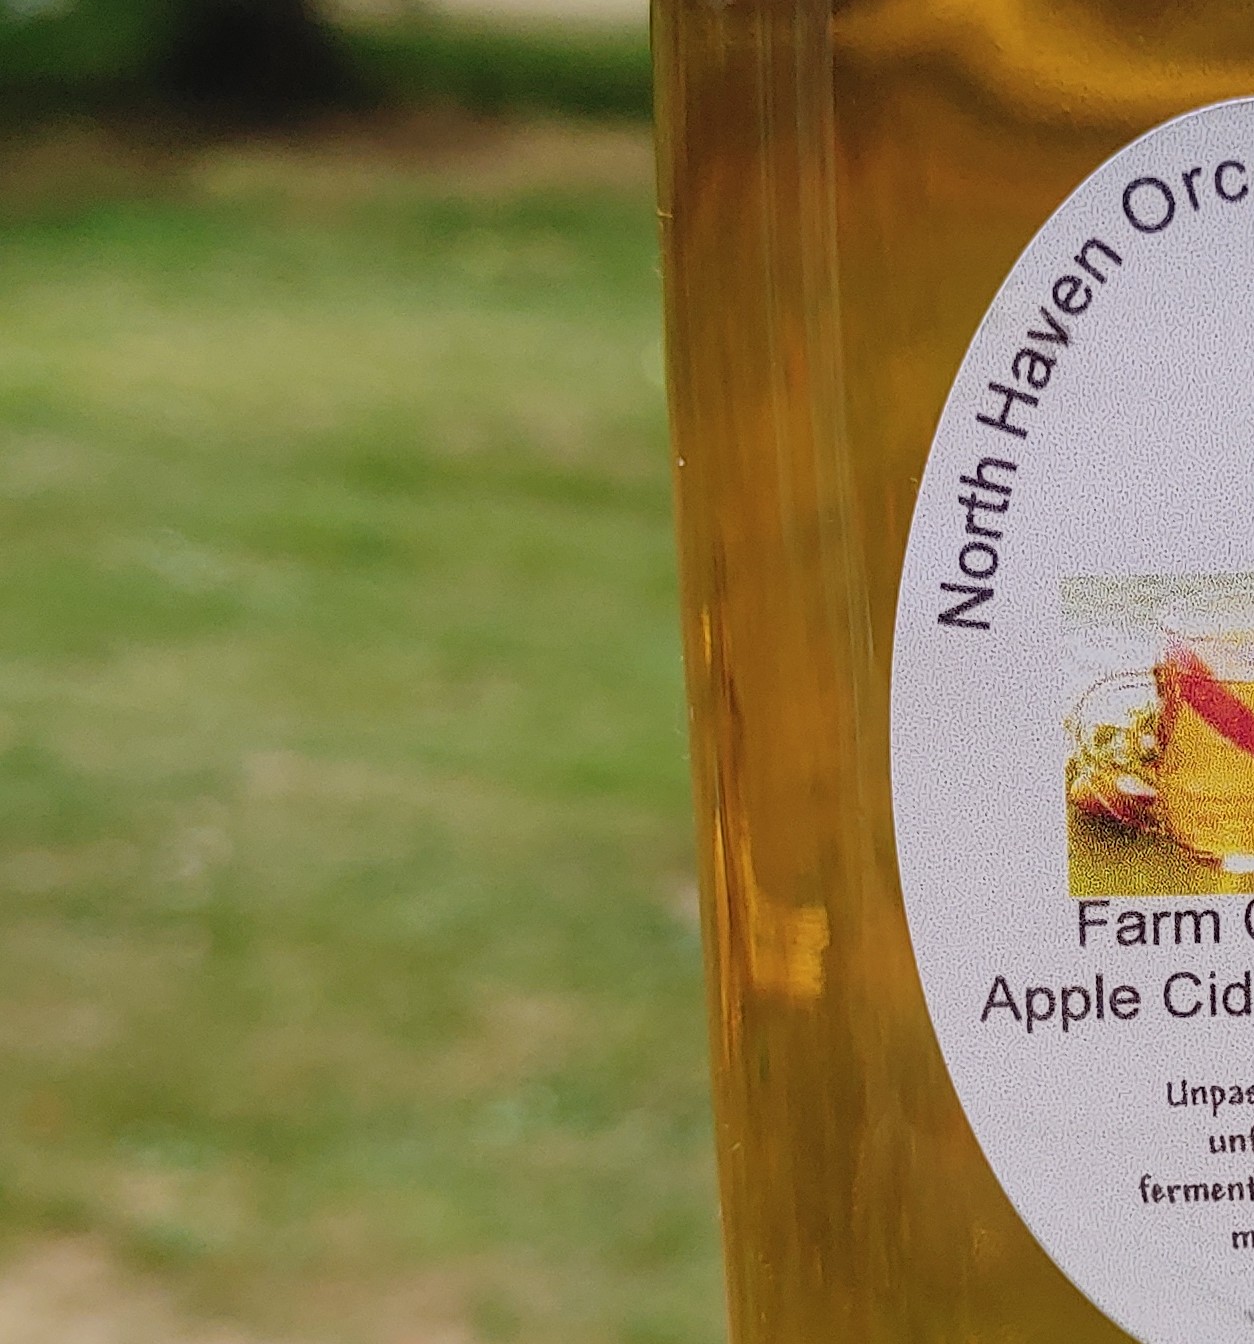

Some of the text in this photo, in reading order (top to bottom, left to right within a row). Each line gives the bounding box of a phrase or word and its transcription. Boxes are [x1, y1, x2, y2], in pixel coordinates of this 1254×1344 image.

[976, 235, 1123, 439] Haven
[937, 456, 1018, 632] North
[1077, 899, 1222, 947] Farm
[980, 975, 1141, 1034] Apple
